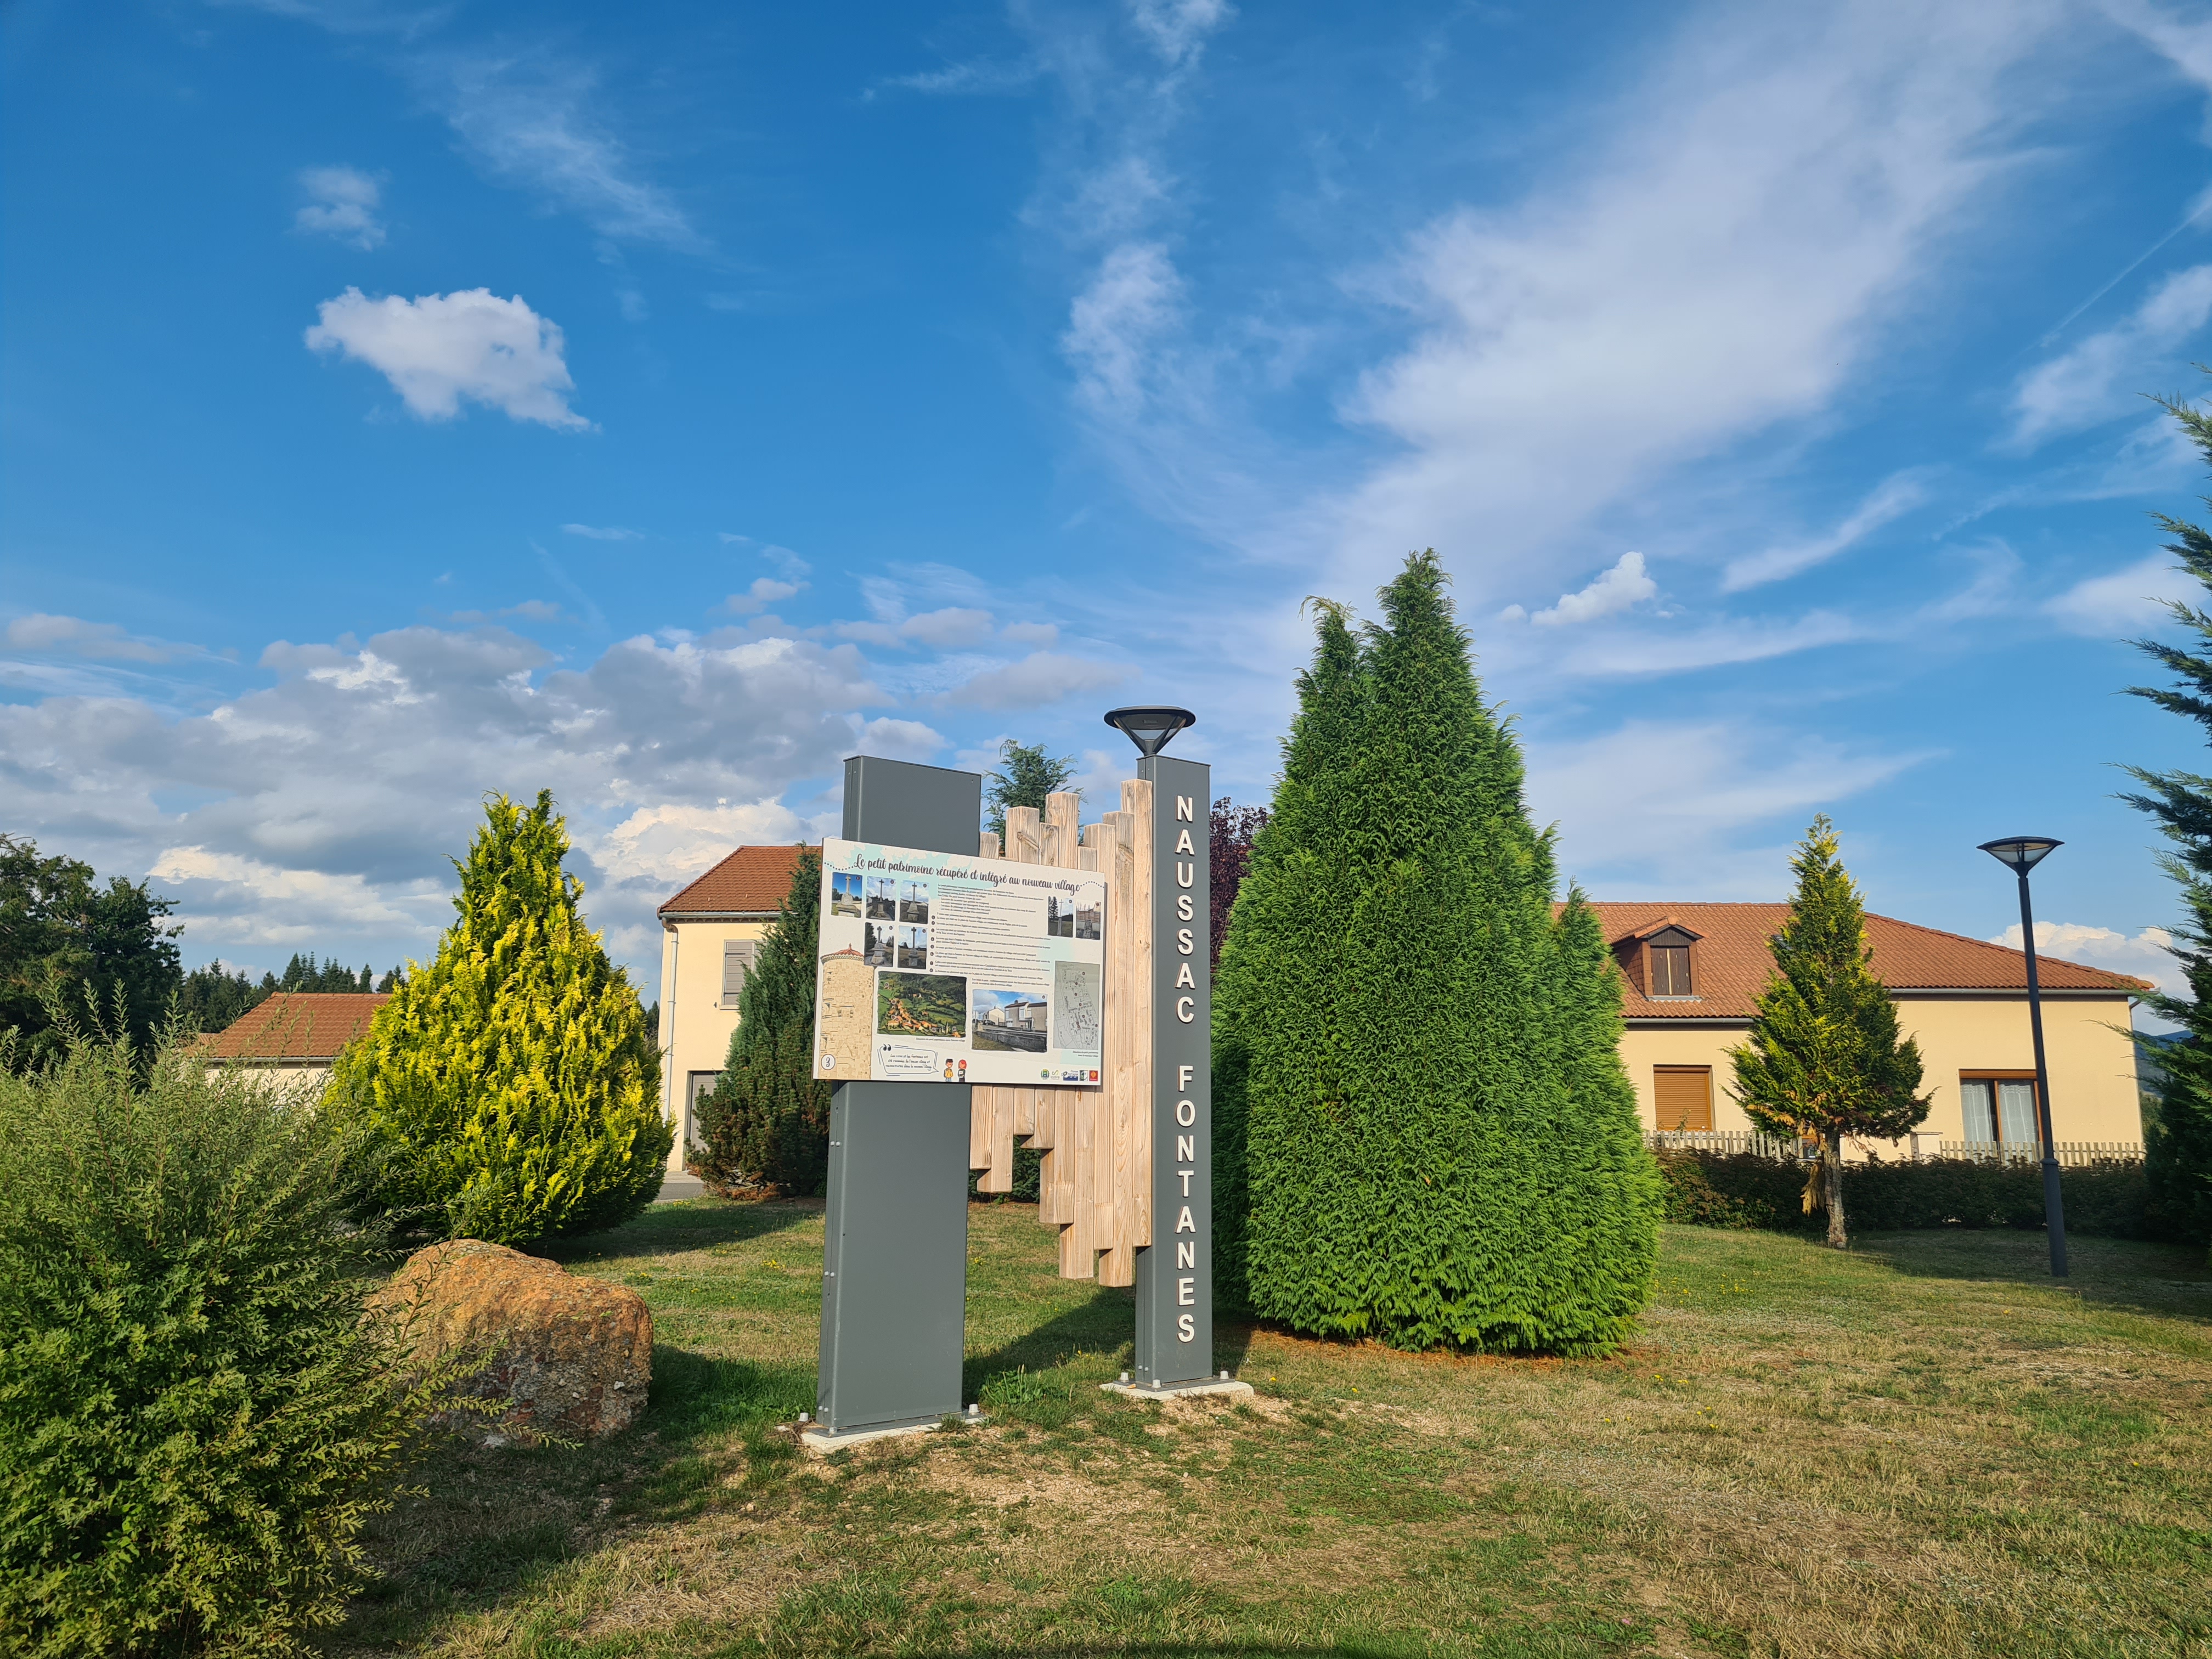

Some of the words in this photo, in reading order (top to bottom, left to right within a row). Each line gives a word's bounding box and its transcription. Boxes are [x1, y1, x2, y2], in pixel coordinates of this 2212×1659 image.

[854, 853, 866, 868] Le
[867, 857, 886, 871] petit
[888, 860, 934, 875] patrimoine
[936, 866, 968, 880] récupéré
[970, 869, 978, 880] et
[979, 871, 1008, 888] intégré
[1008, 877, 1020, 885] au
[1022, 878, 1053, 889] nouveau
[1054, 879, 1080, 896] village
[1176, 795, 1195, 1023] NAUSSAC
[826, 1057, 830, 1067] 3
[1176, 1065, 1196, 1342] FONTANES
